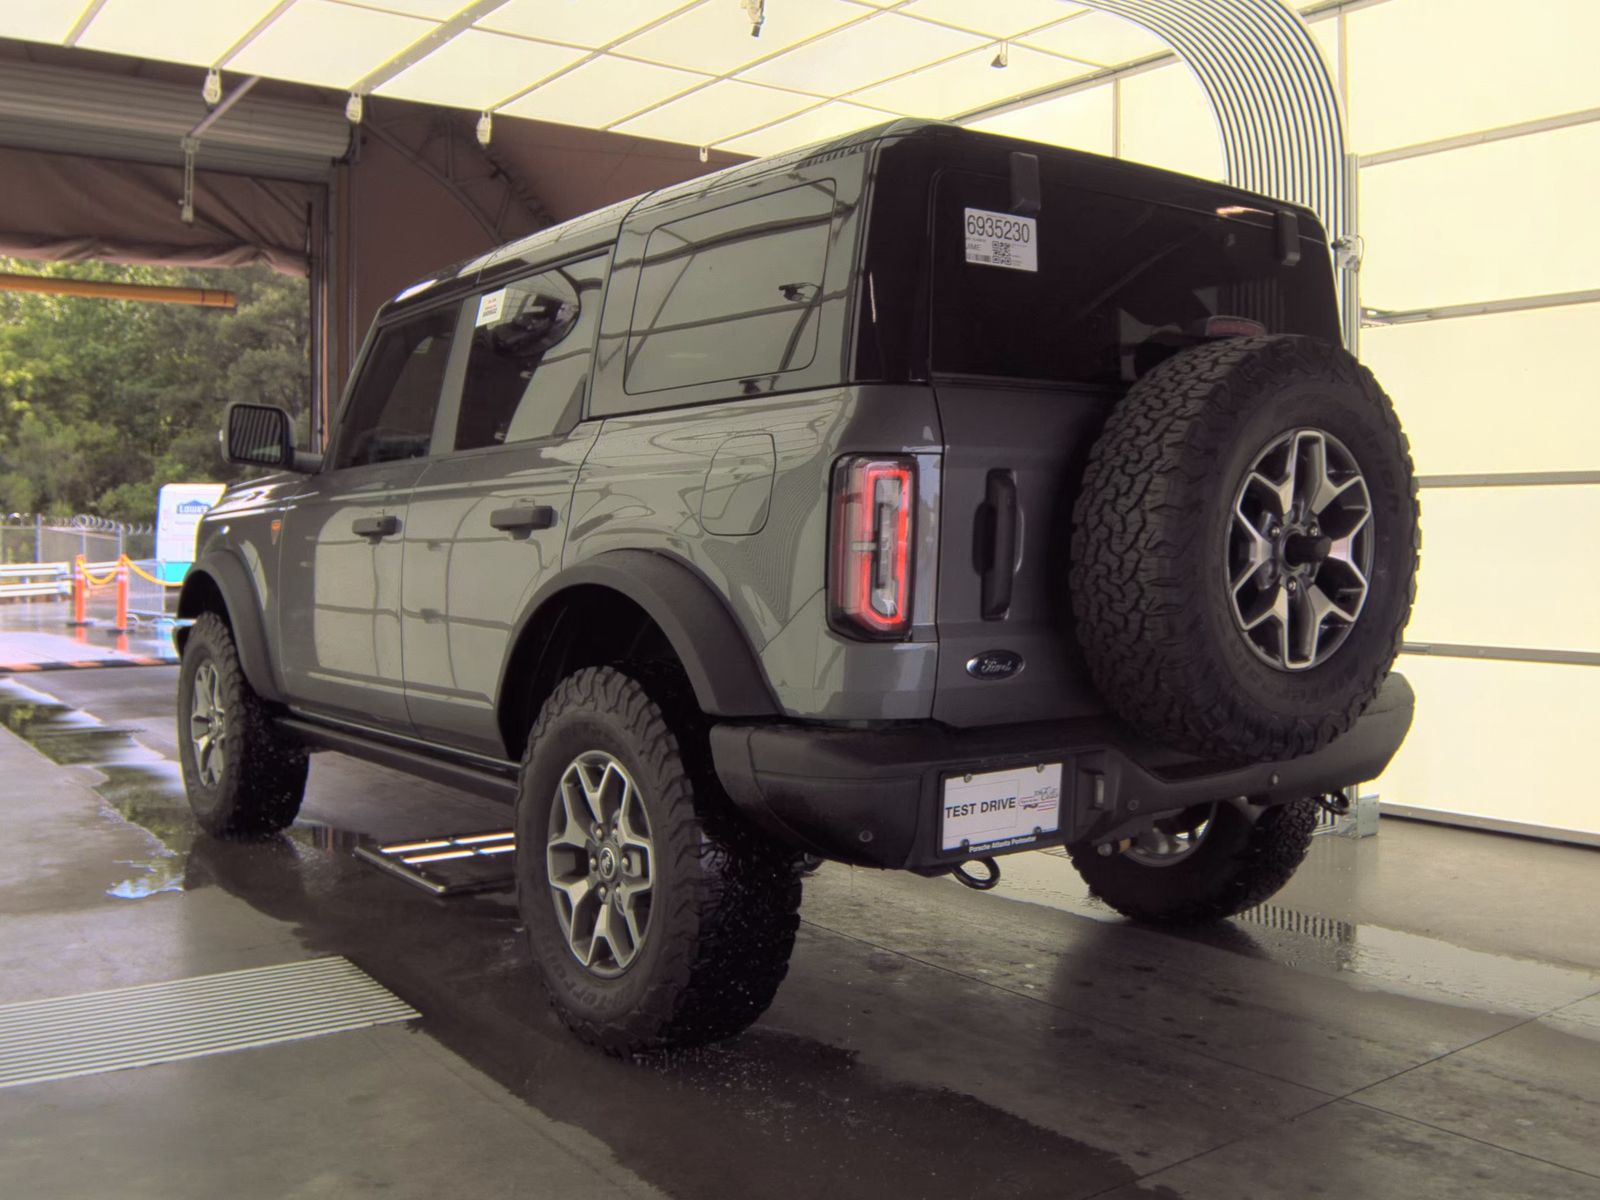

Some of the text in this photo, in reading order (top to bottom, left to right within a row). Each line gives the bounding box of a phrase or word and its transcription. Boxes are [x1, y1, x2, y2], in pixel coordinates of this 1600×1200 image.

[967, 215, 1030, 243] 6935230
[981, 659, 1012, 673] Ford
[945, 803, 977, 818] TEST
[981, 797, 1017, 814] DRIVE
